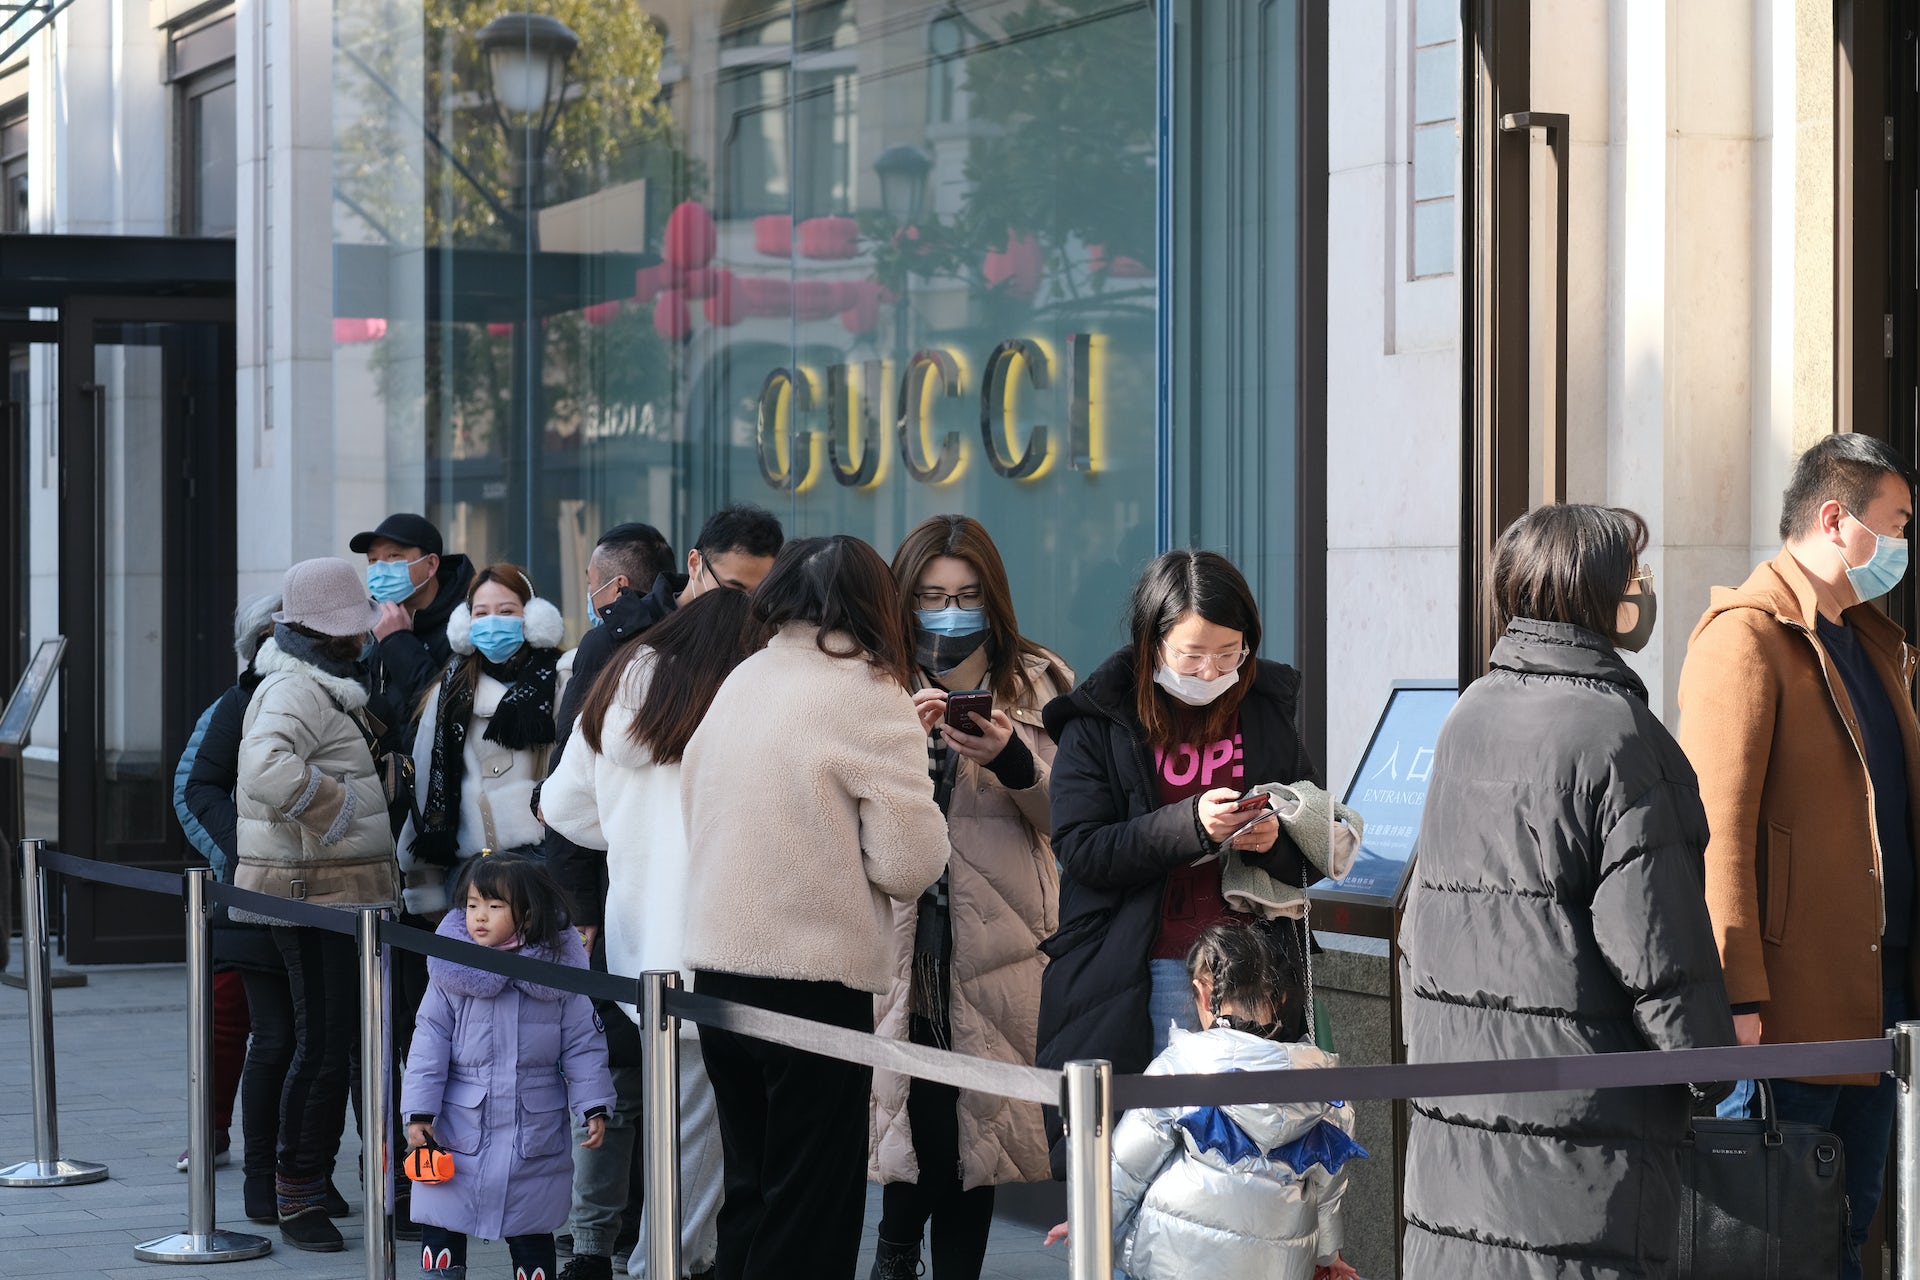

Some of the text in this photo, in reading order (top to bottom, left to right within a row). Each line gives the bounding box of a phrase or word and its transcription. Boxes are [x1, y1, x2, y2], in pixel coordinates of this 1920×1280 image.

[757, 333, 1100, 491] GUCCI
[1371, 740, 1435, 782] 入口
[1363, 788, 1425, 805] ENTRANCE
